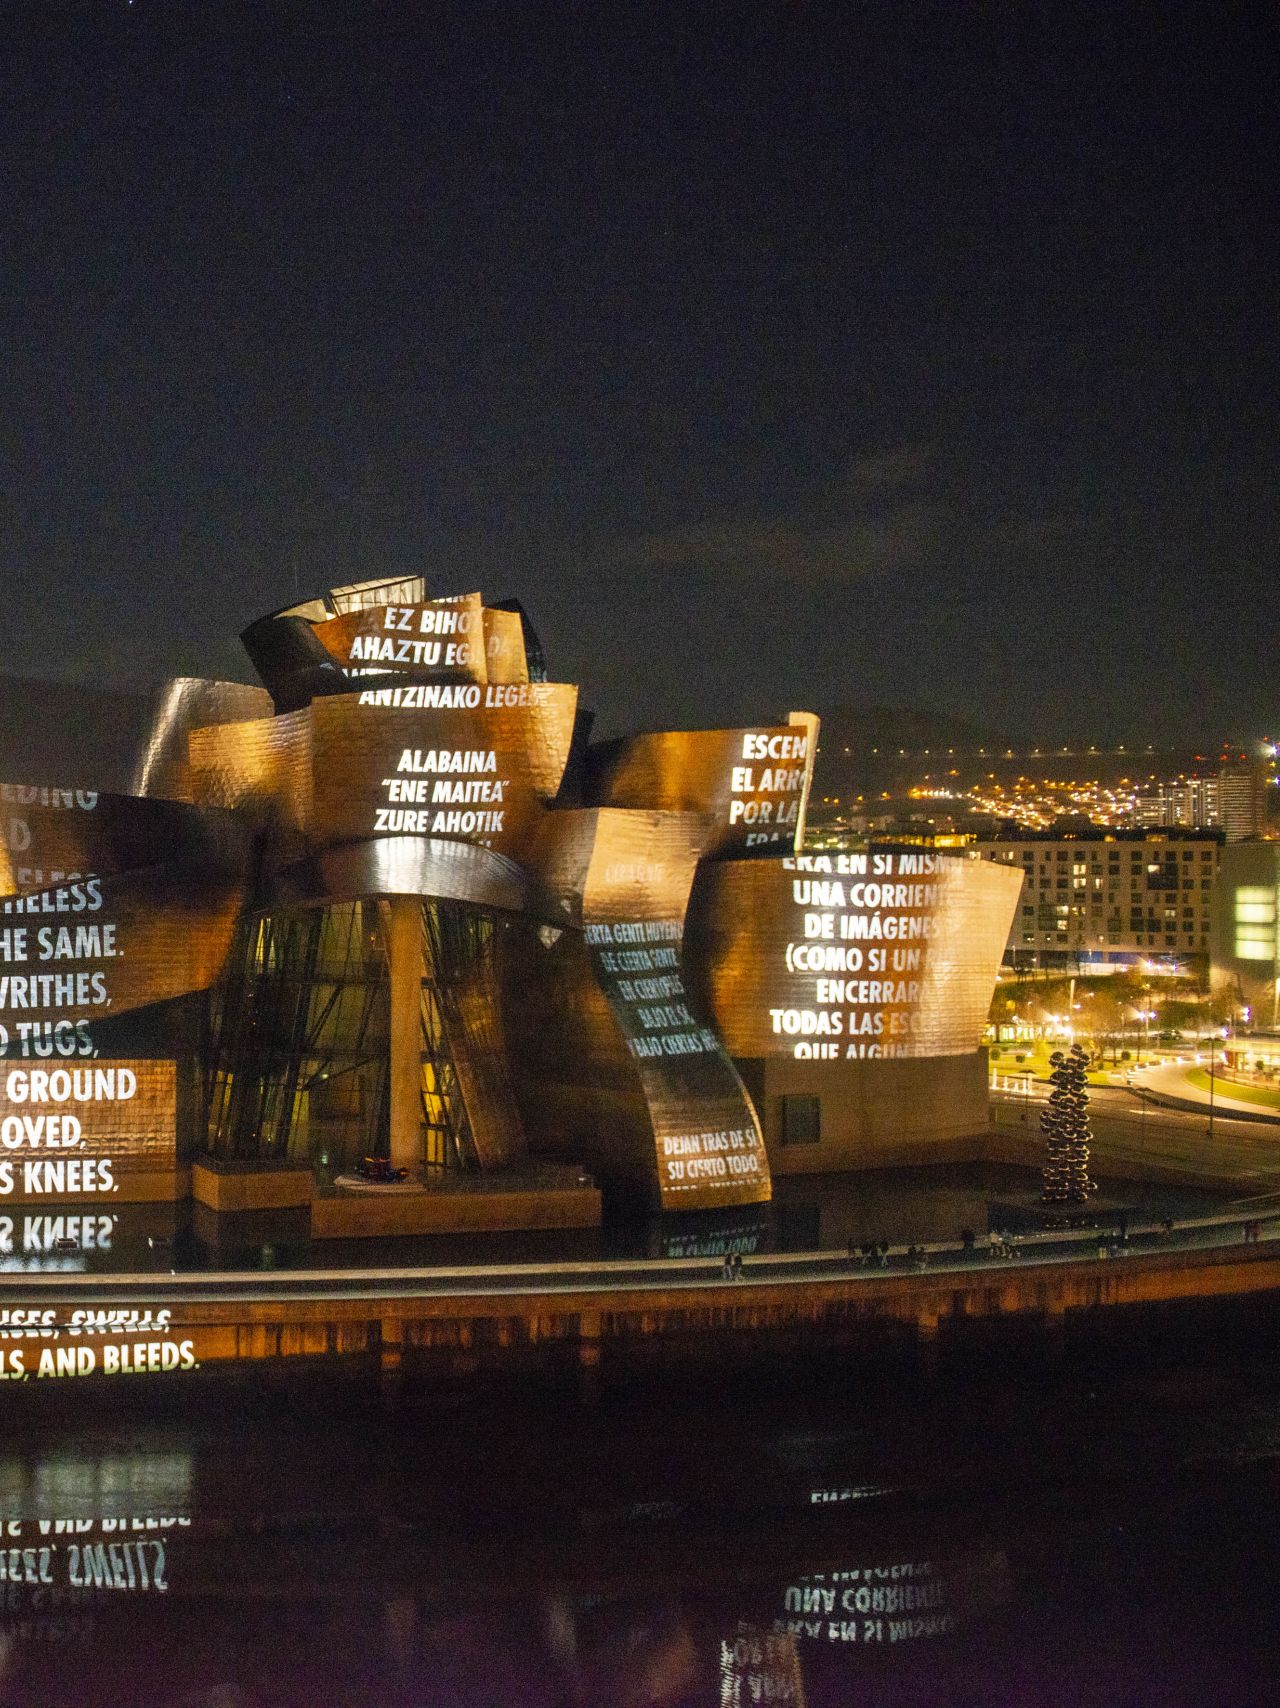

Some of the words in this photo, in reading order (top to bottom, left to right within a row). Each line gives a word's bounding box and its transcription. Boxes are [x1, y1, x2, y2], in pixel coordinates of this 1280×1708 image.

[384, 607, 415, 631] EZ
[349, 637, 441, 665] AHAZTU
[742, 734, 808, 759] ESCEN
[397, 749, 497, 772] ALABAINA
[731, 767, 755, 792] EL
[373, 809, 429, 832] ZURE
[431, 811, 505, 833] AHOTIK
[729, 800, 773, 824] POR
[776, 800, 799, 823] LA
[838, 854, 867, 875] EN
[793, 880, 846, 907] UNA
[804, 913, 835, 939] DE
[37, 924, 125, 960] SAME.
[785, 943, 863, 972] (COMO
[868, 948, 886, 972] SI
[893, 948, 920, 971] UN
[769, 1009, 844, 1035] TODAS
[849, 1012, 884, 1035] LAS
[16, 1019, 100, 1058] TUGS,
[6, 1068, 137, 1103] GROUND
[663, 1135, 700, 1155] DEJAN
[700, 1131, 729, 1151] TRAS
[729, 1129, 745, 1149] DE
[23, 1159, 120, 1194] KNEES,
[668, 1160, 685, 1180] SU
[37, 1347, 96, 1379] AND
[103, 1340, 200, 1374] BLEEDS.
